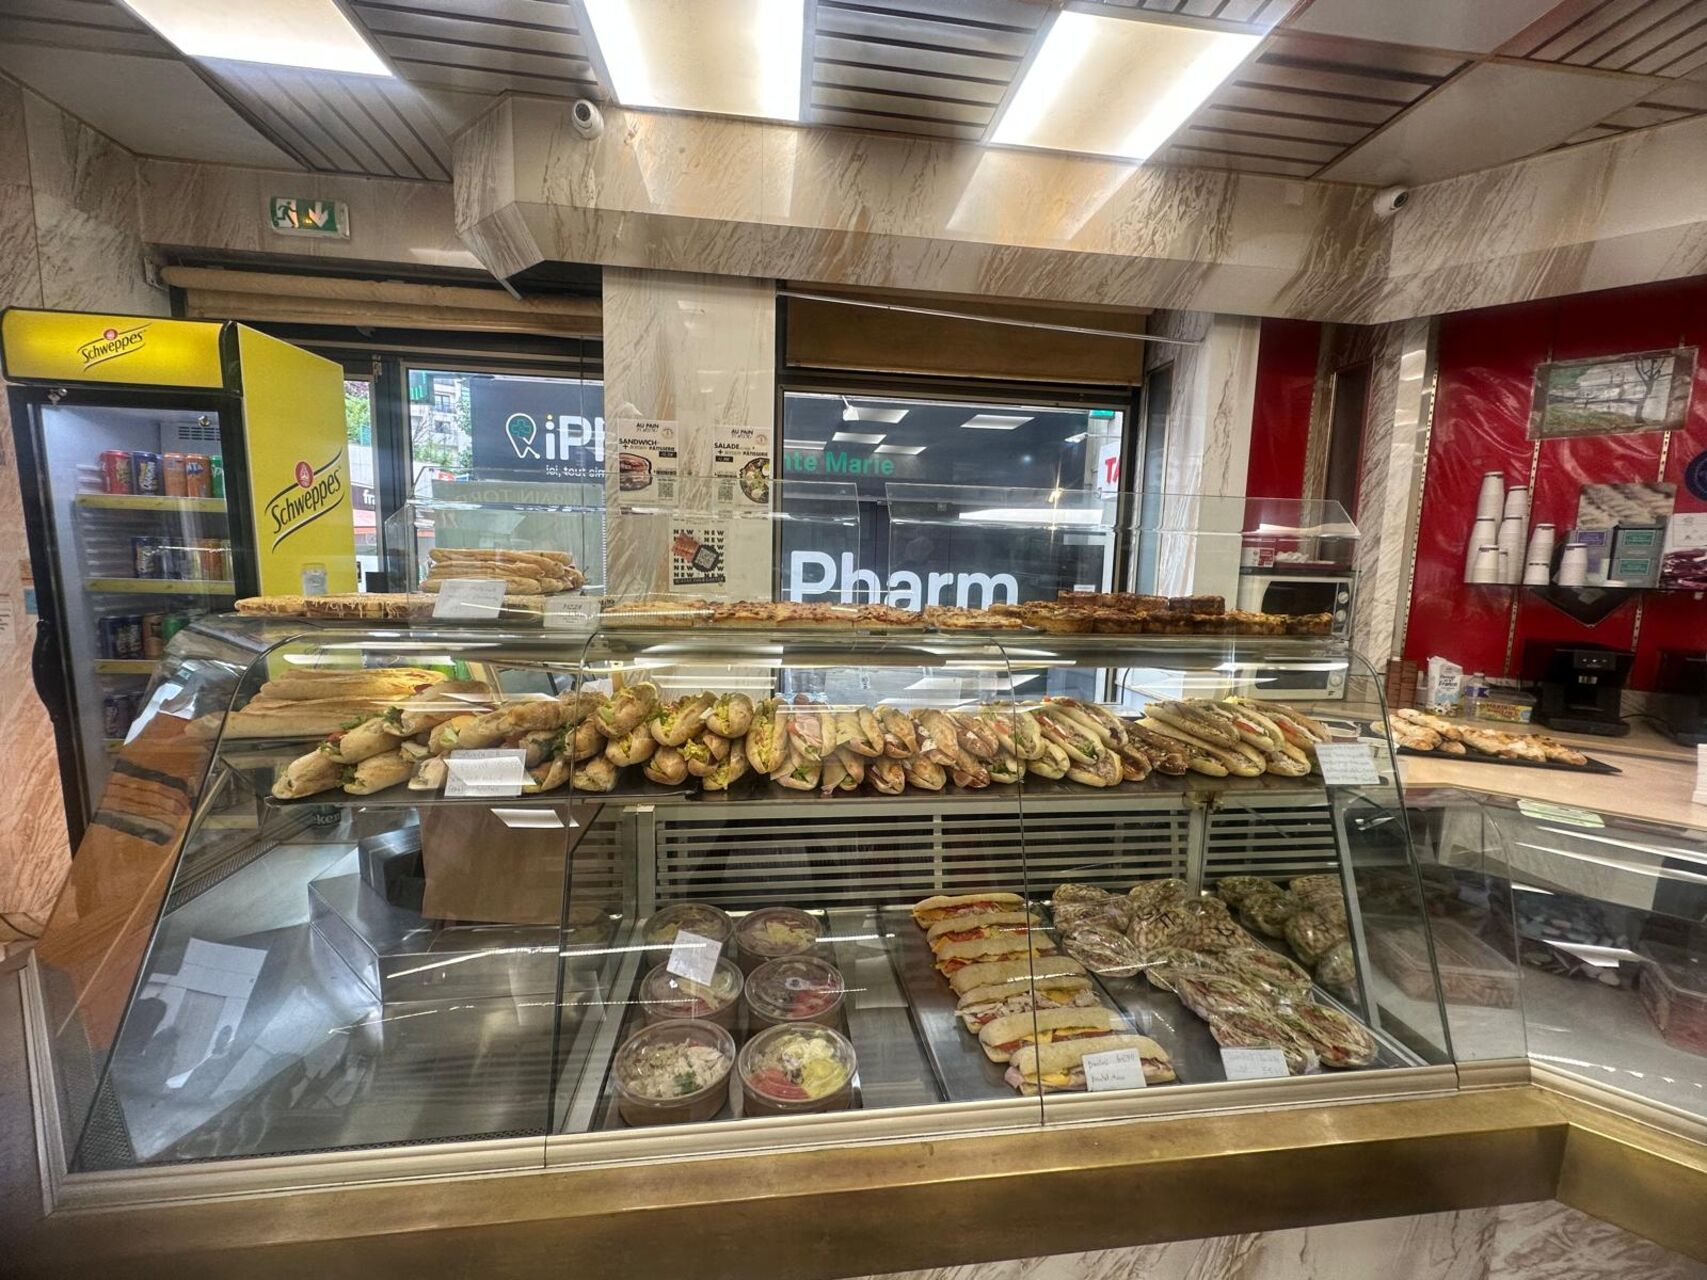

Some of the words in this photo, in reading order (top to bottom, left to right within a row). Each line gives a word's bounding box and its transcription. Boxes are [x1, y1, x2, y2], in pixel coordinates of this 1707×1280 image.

[81, 331, 143, 364] Schweppes
[619, 438, 657, 446] SANDWICH
[714, 442, 740, 450] SALADE
[825, 450, 895, 475] Marie
[271, 469, 341, 535] Schweppes
[790, 550, 1019, 613] Pharm
